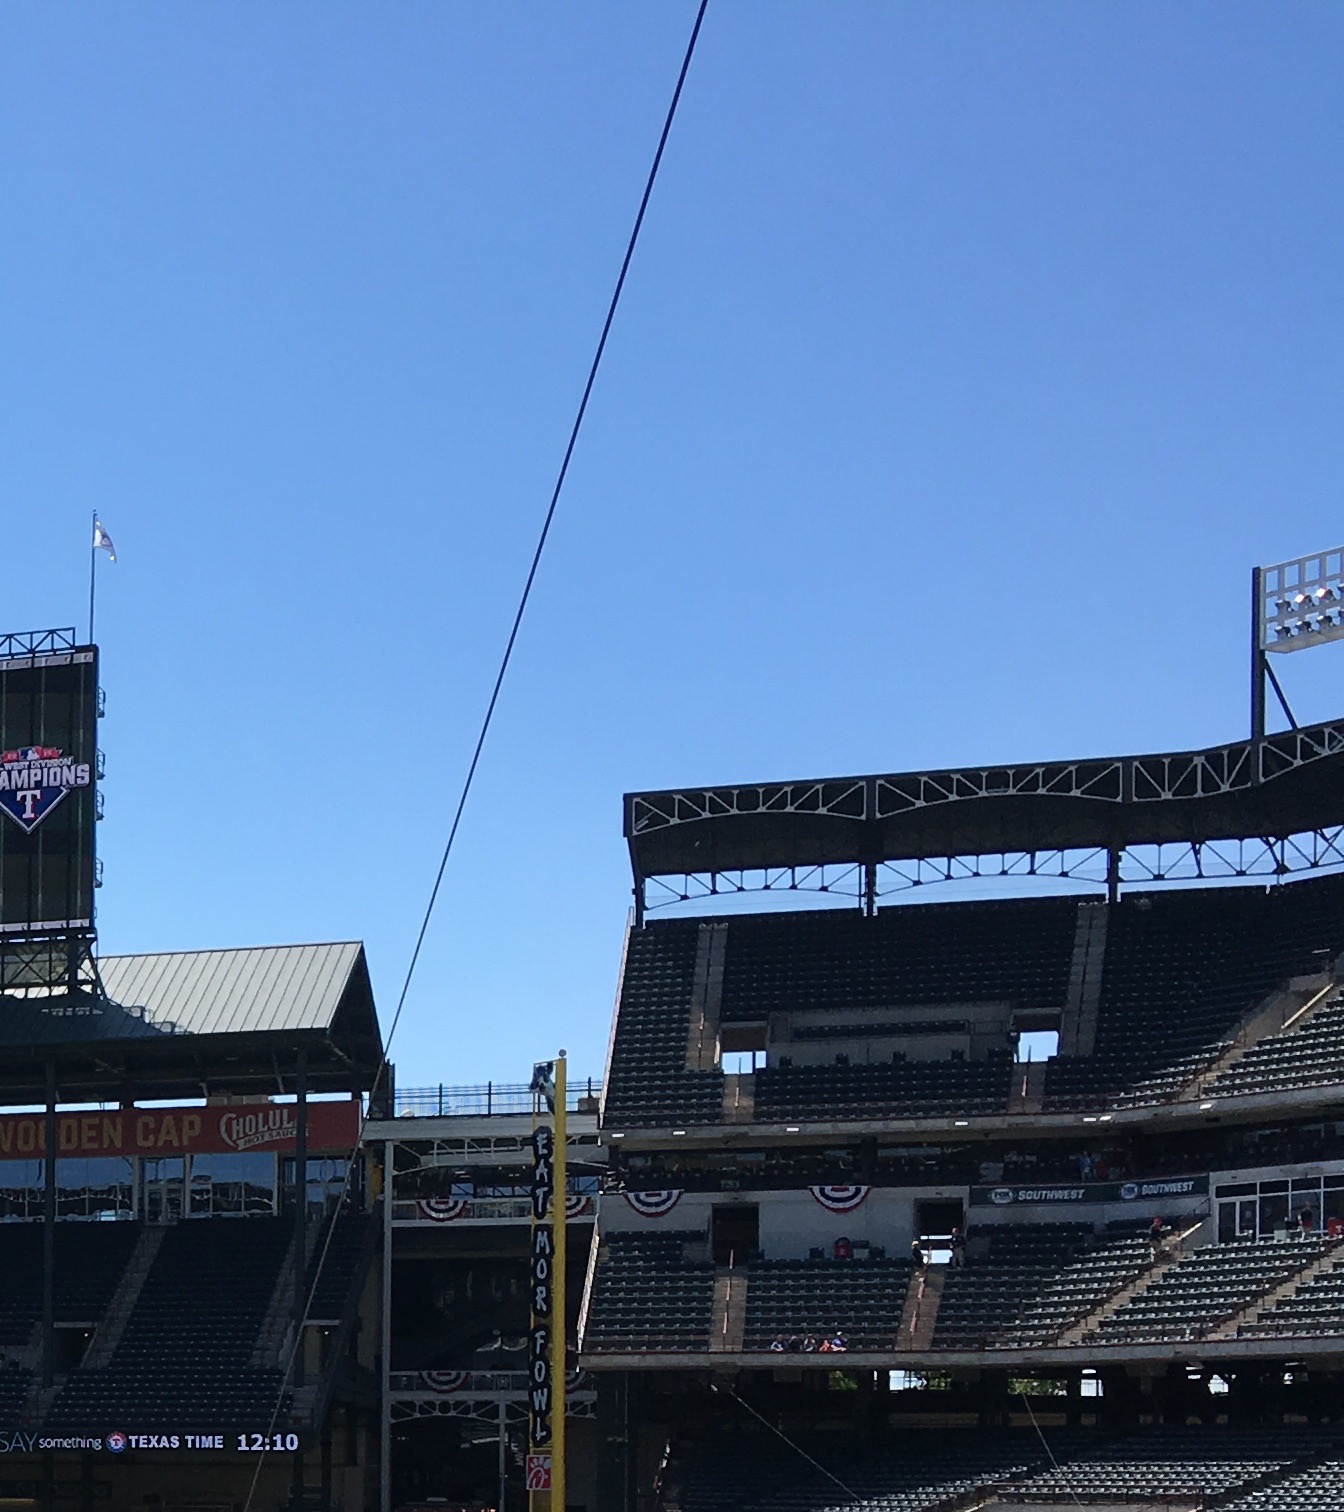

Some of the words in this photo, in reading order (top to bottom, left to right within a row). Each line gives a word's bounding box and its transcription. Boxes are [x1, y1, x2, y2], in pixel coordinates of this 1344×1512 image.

[17, 790, 41, 819] T
[136, 1113, 202, 1148] CAP
[219, 1108, 298, 1148] CHOLUL
[535, 1132, 549, 1213] EAT
[1141, 1181, 1194, 1196] SOUTHWEST
[1017, 1189, 1085, 1201] SOUTHWEST
[535, 1231, 550, 1312] MOR
[533, 1330, 549, 1442] FOWL
[38, 1434, 103, 1450] something
[128, 1435, 181, 1449] TEXAS
[184, 1435, 224, 1449] TIME
[237, 1433, 299, 1451] 12:10
